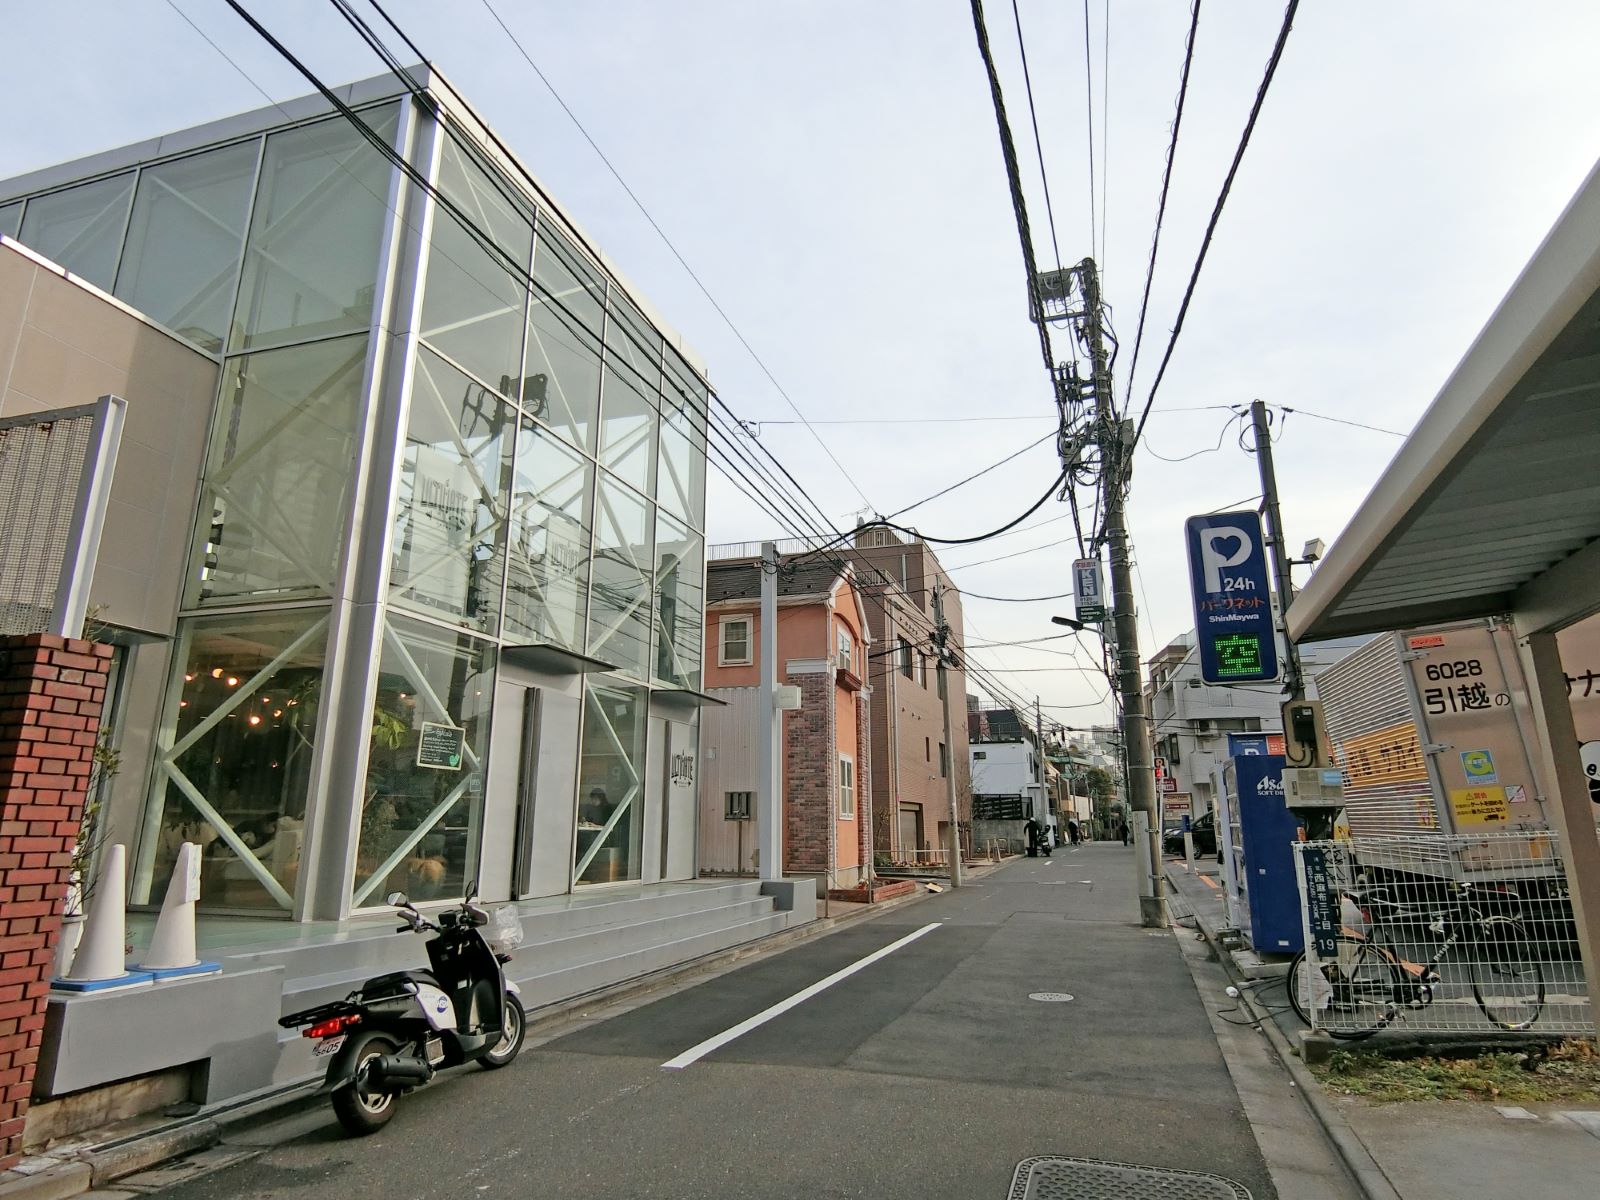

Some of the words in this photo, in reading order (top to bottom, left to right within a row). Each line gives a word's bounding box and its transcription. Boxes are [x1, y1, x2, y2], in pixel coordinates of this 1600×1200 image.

[1081, 570, 1095, 596] KEN
[1223, 577, 1256, 592] 24h
[1201, 596, 1265, 611] パークネット
[1208, 613, 1260, 623] ShinMaywa
[1215, 634, 1261, 675] 空
[1425, 659, 1483, 681] 6028
[1314, 873, 1331, 930] 西麻布三丁目
[1320, 939, 1335, 950] 19
